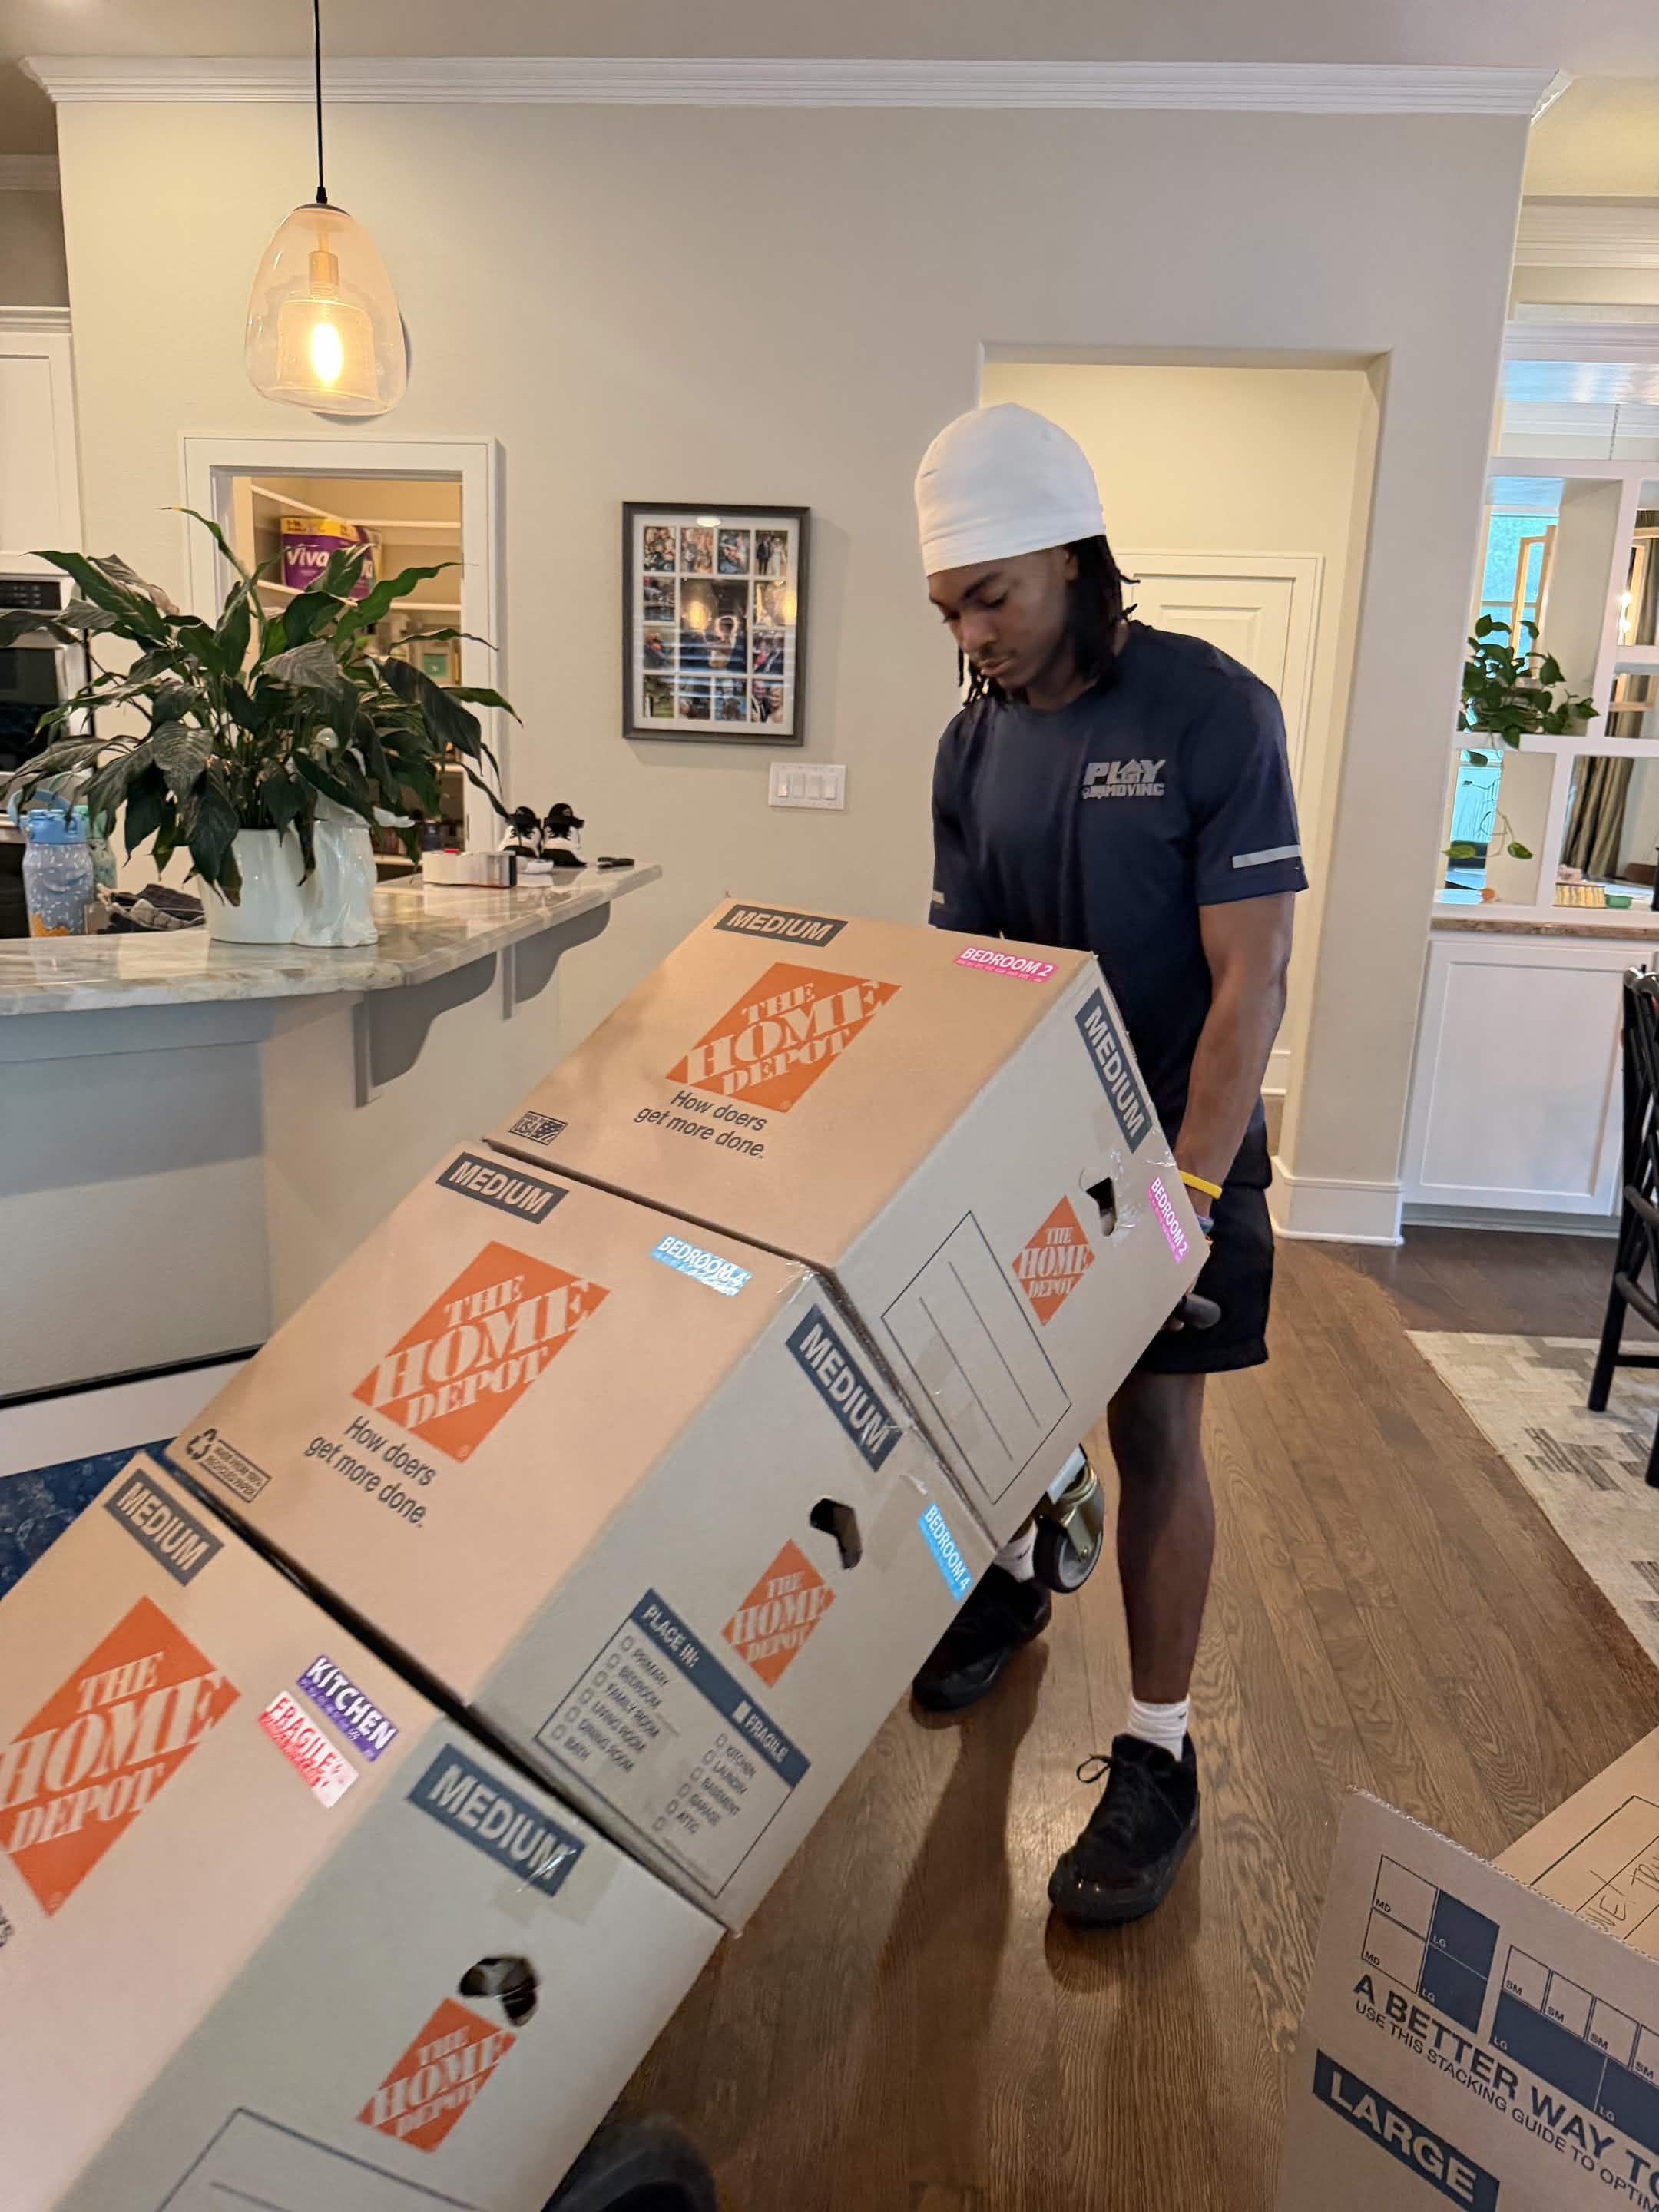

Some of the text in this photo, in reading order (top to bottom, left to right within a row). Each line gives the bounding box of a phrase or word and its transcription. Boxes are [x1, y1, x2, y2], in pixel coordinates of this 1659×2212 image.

[286, 544, 330, 567] Viva
[1083, 759, 1166, 785] PLAY
[1106, 783, 1164, 797] MOVING
[726, 910, 833, 941] MEDIUM
[960, 948, 1041, 974] BEDROOM
[1038, 965, 1054, 976] 2
[741, 983, 815, 1025] THE
[687, 980, 880, 1084] HOME
[723, 1028, 850, 1096] DEPOT
[1084, 1005, 1146, 1135] MEDIUM
[634, 1106, 766, 1159] get more done.
[671, 1090, 767, 1131] How doers
[450, 1160, 553, 1216] MEDIUM
[1046, 1227, 1073, 1245] THE
[1151, 1177, 1184, 1247] BEDROOM
[1179, 1241, 1188, 1257] 2
[657, 1236, 737, 1282] BEDROOM
[1018, 1244, 1089, 1279] HOME
[443, 1274, 525, 1327] THE
[1028, 1277, 1074, 1298] DEPOT
[372, 1278, 590, 1409] HOME
[405, 1346, 550, 1429] DEPOT
[800, 1323, 889, 1454] MEDIUM
[344, 1416, 437, 1487] How doers
[304, 1435, 427, 1528] get more done.
[117, 1482, 210, 1571] MEDIUM
[925, 1505, 967, 1581] BEDROOM
[960, 1577, 972, 1591] 4
[767, 1570, 806, 1598] THE
[641, 1604, 686, 1651] PLACE
[732, 1585, 830, 1646] HOME
[76, 1651, 164, 1714] THE
[307, 1657, 398, 1750] KITCHEN
[0, 1671, 223, 1810] HOME
[745, 1714, 790, 1763] FRAGILE
[5, 1762, 166, 1854] DEPOT
[429, 1763, 570, 1880] MEDIUM
[1376, 1899, 1391, 1912] MD
[1365, 1951, 1380, 1965] MD
[1433, 1935, 1446, 1949] LG
[1422, 1987, 1435, 2003] LG
[1505, 1979, 1522, 1995] SM
[1547, 2006, 1565, 2022] SM
[417, 2025, 472, 2065] THE
[1353, 1973, 1375, 2004] A
[1386, 1990, 1518, 2100] BETTER
[1532, 2085, 1614, 2159] WAY
[1494, 2035, 1508, 2050] LG
[1591, 2033, 1608, 2050] SM
[374, 2028, 507, 2127] HOME
[1356, 1999, 1386, 2029] USE
[1390, 2024, 1423, 2054] THIS
[1427, 2049, 1507, 2112] STACKING
[1512, 2108, 1566, 2154] GUIDE
[1571, 2145, 1595, 2171] TO
[1635, 2061, 1654, 2079] SM
[1330, 2070, 1477, 2204] LARGE
[1599, 2105, 1615, 2121] LG
